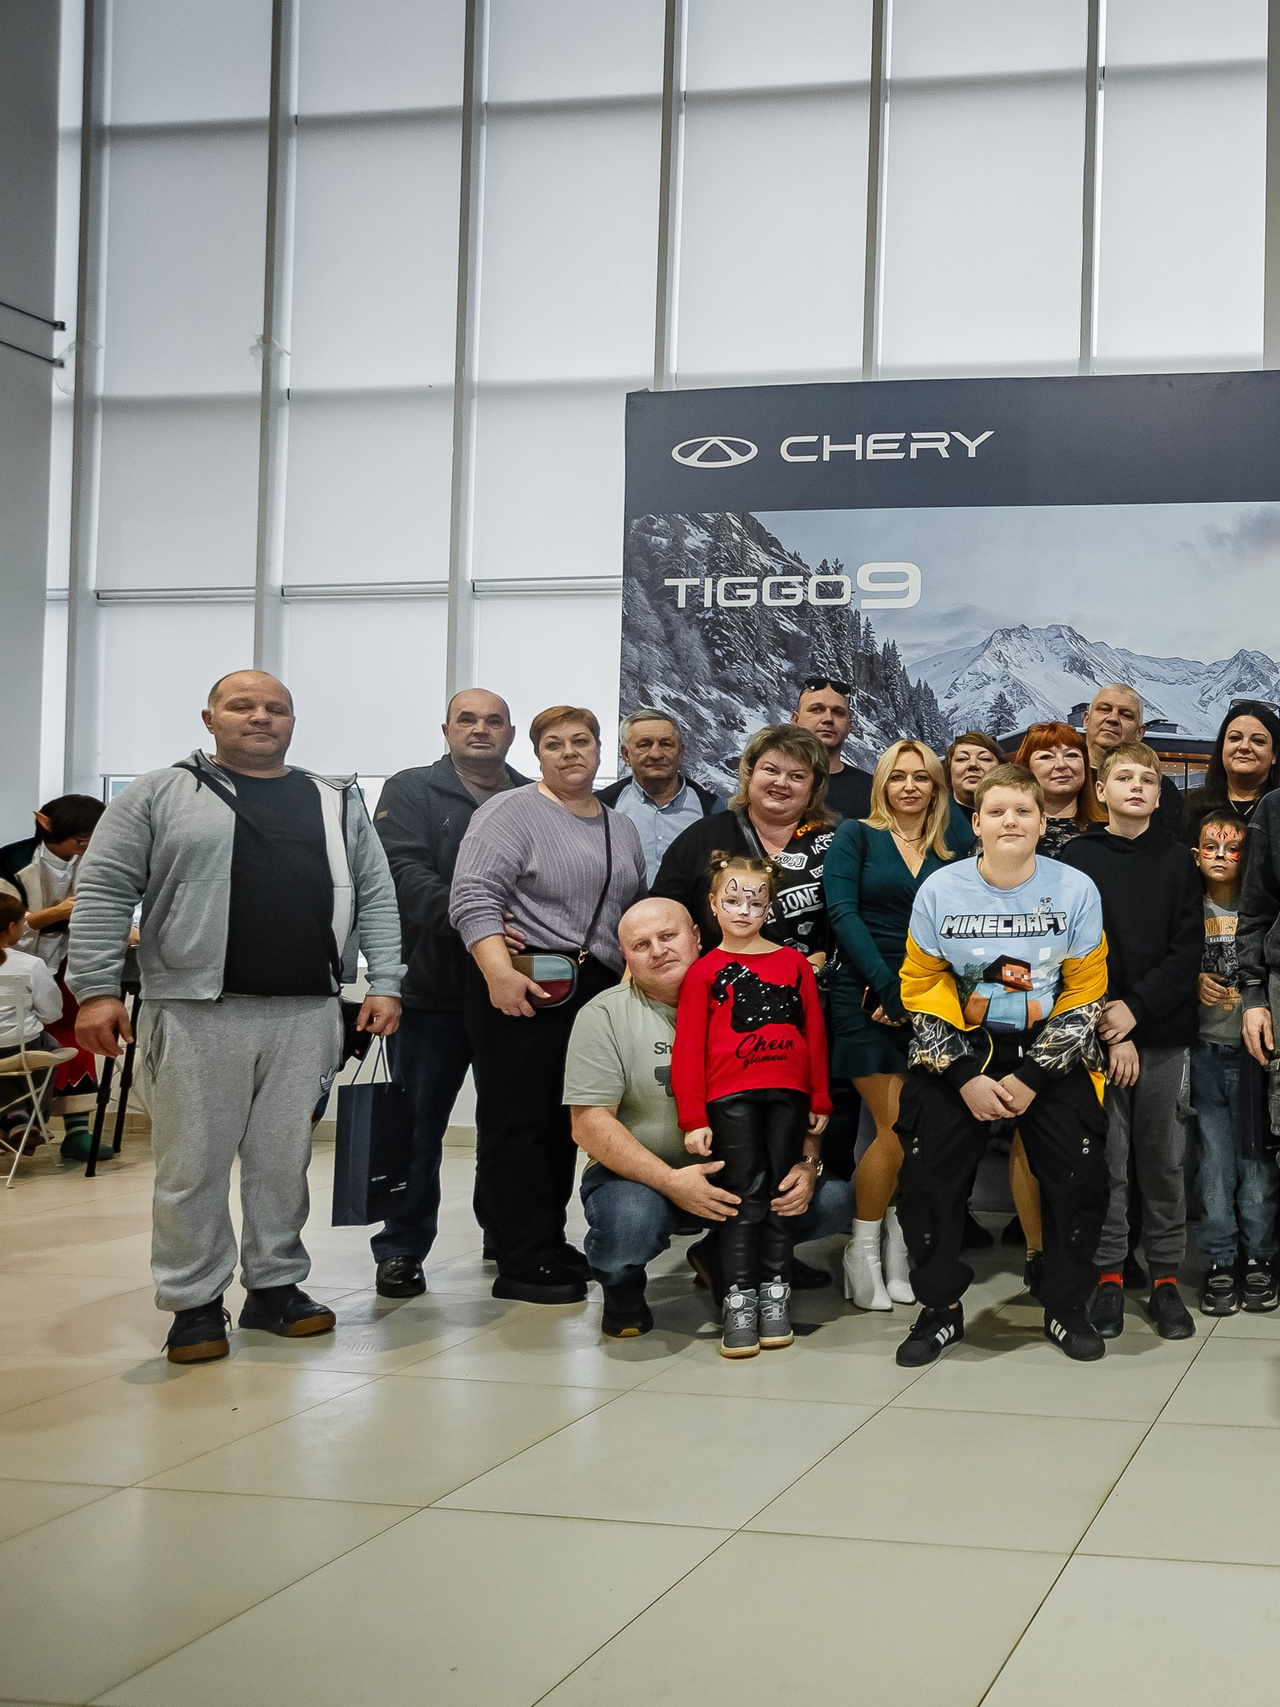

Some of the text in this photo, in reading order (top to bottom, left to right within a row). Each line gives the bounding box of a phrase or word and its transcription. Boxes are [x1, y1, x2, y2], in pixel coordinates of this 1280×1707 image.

[779, 430, 995, 463] CHERY
[939, 911, 1067, 939] MINECRAFT
[653, 1041, 673, 1055] Sh
